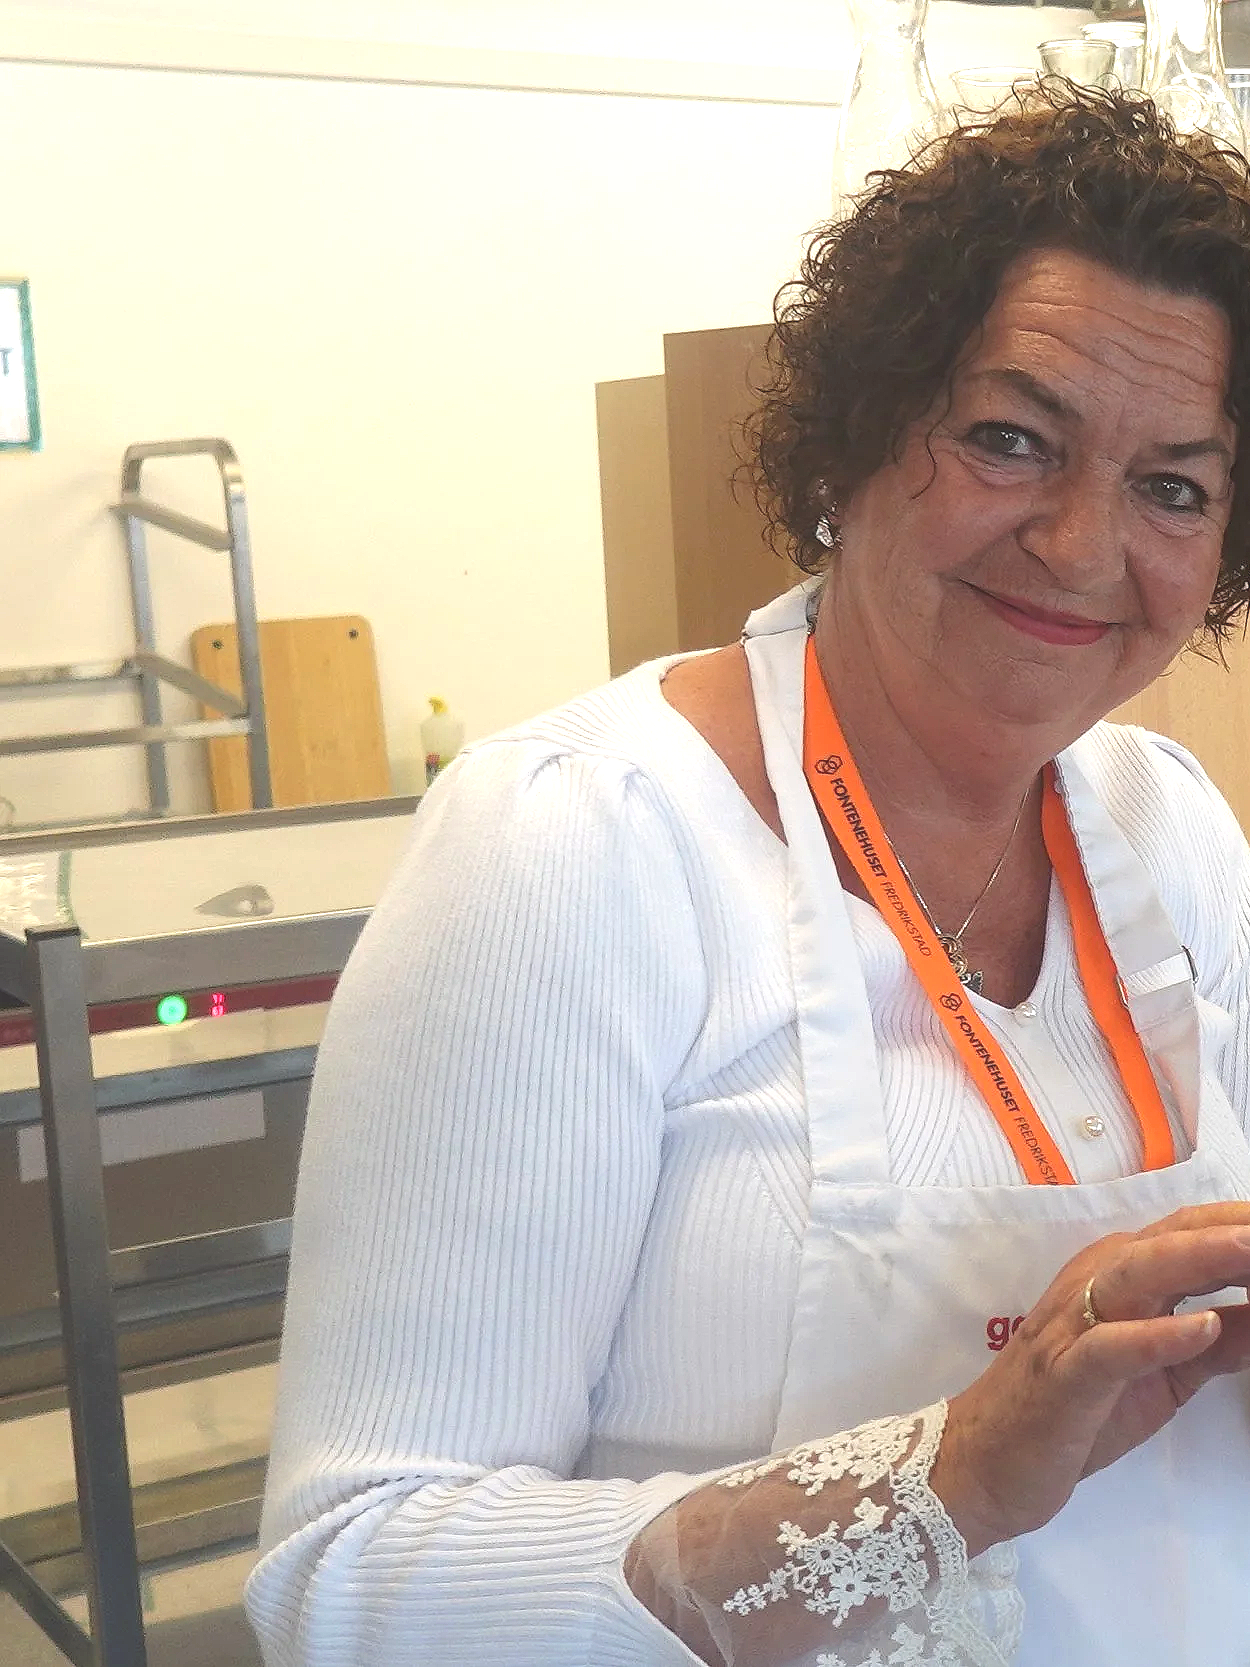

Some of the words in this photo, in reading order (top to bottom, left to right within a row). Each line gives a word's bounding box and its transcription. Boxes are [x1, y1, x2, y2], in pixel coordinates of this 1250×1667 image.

[831, 778, 887, 878] FONTENEHUSET
[882, 880, 931, 957] FREDRIKSTAD
[956, 1014, 1020, 1112] FONTENEHUSET
